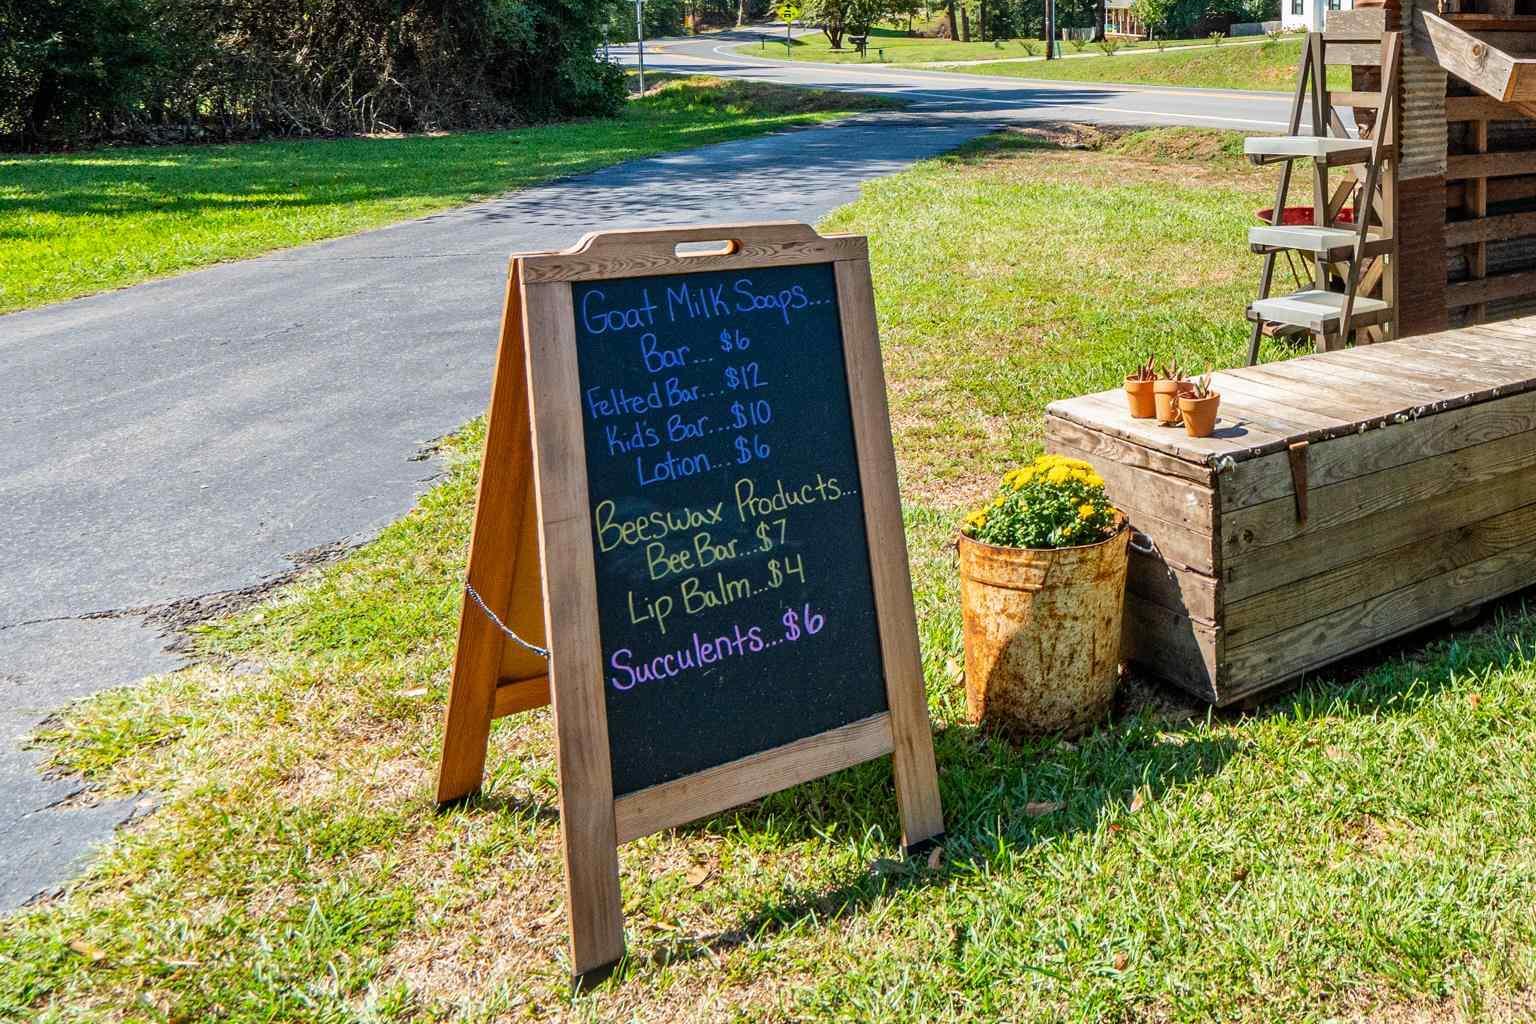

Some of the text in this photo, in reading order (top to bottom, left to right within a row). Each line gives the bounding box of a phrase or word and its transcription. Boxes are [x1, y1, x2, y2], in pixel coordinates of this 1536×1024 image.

[583, 288, 656, 334] Goat
[719, 329, 750, 352] $6
[586, 382, 662, 419] Felted
[724, 362, 769, 390] $12
[730, 400, 772, 429] $10
[735, 435, 770, 465] $6
[595, 500, 723, 552] Beeswax
[646, 542, 695, 580] Bee
[628, 591, 673, 635] Lip
